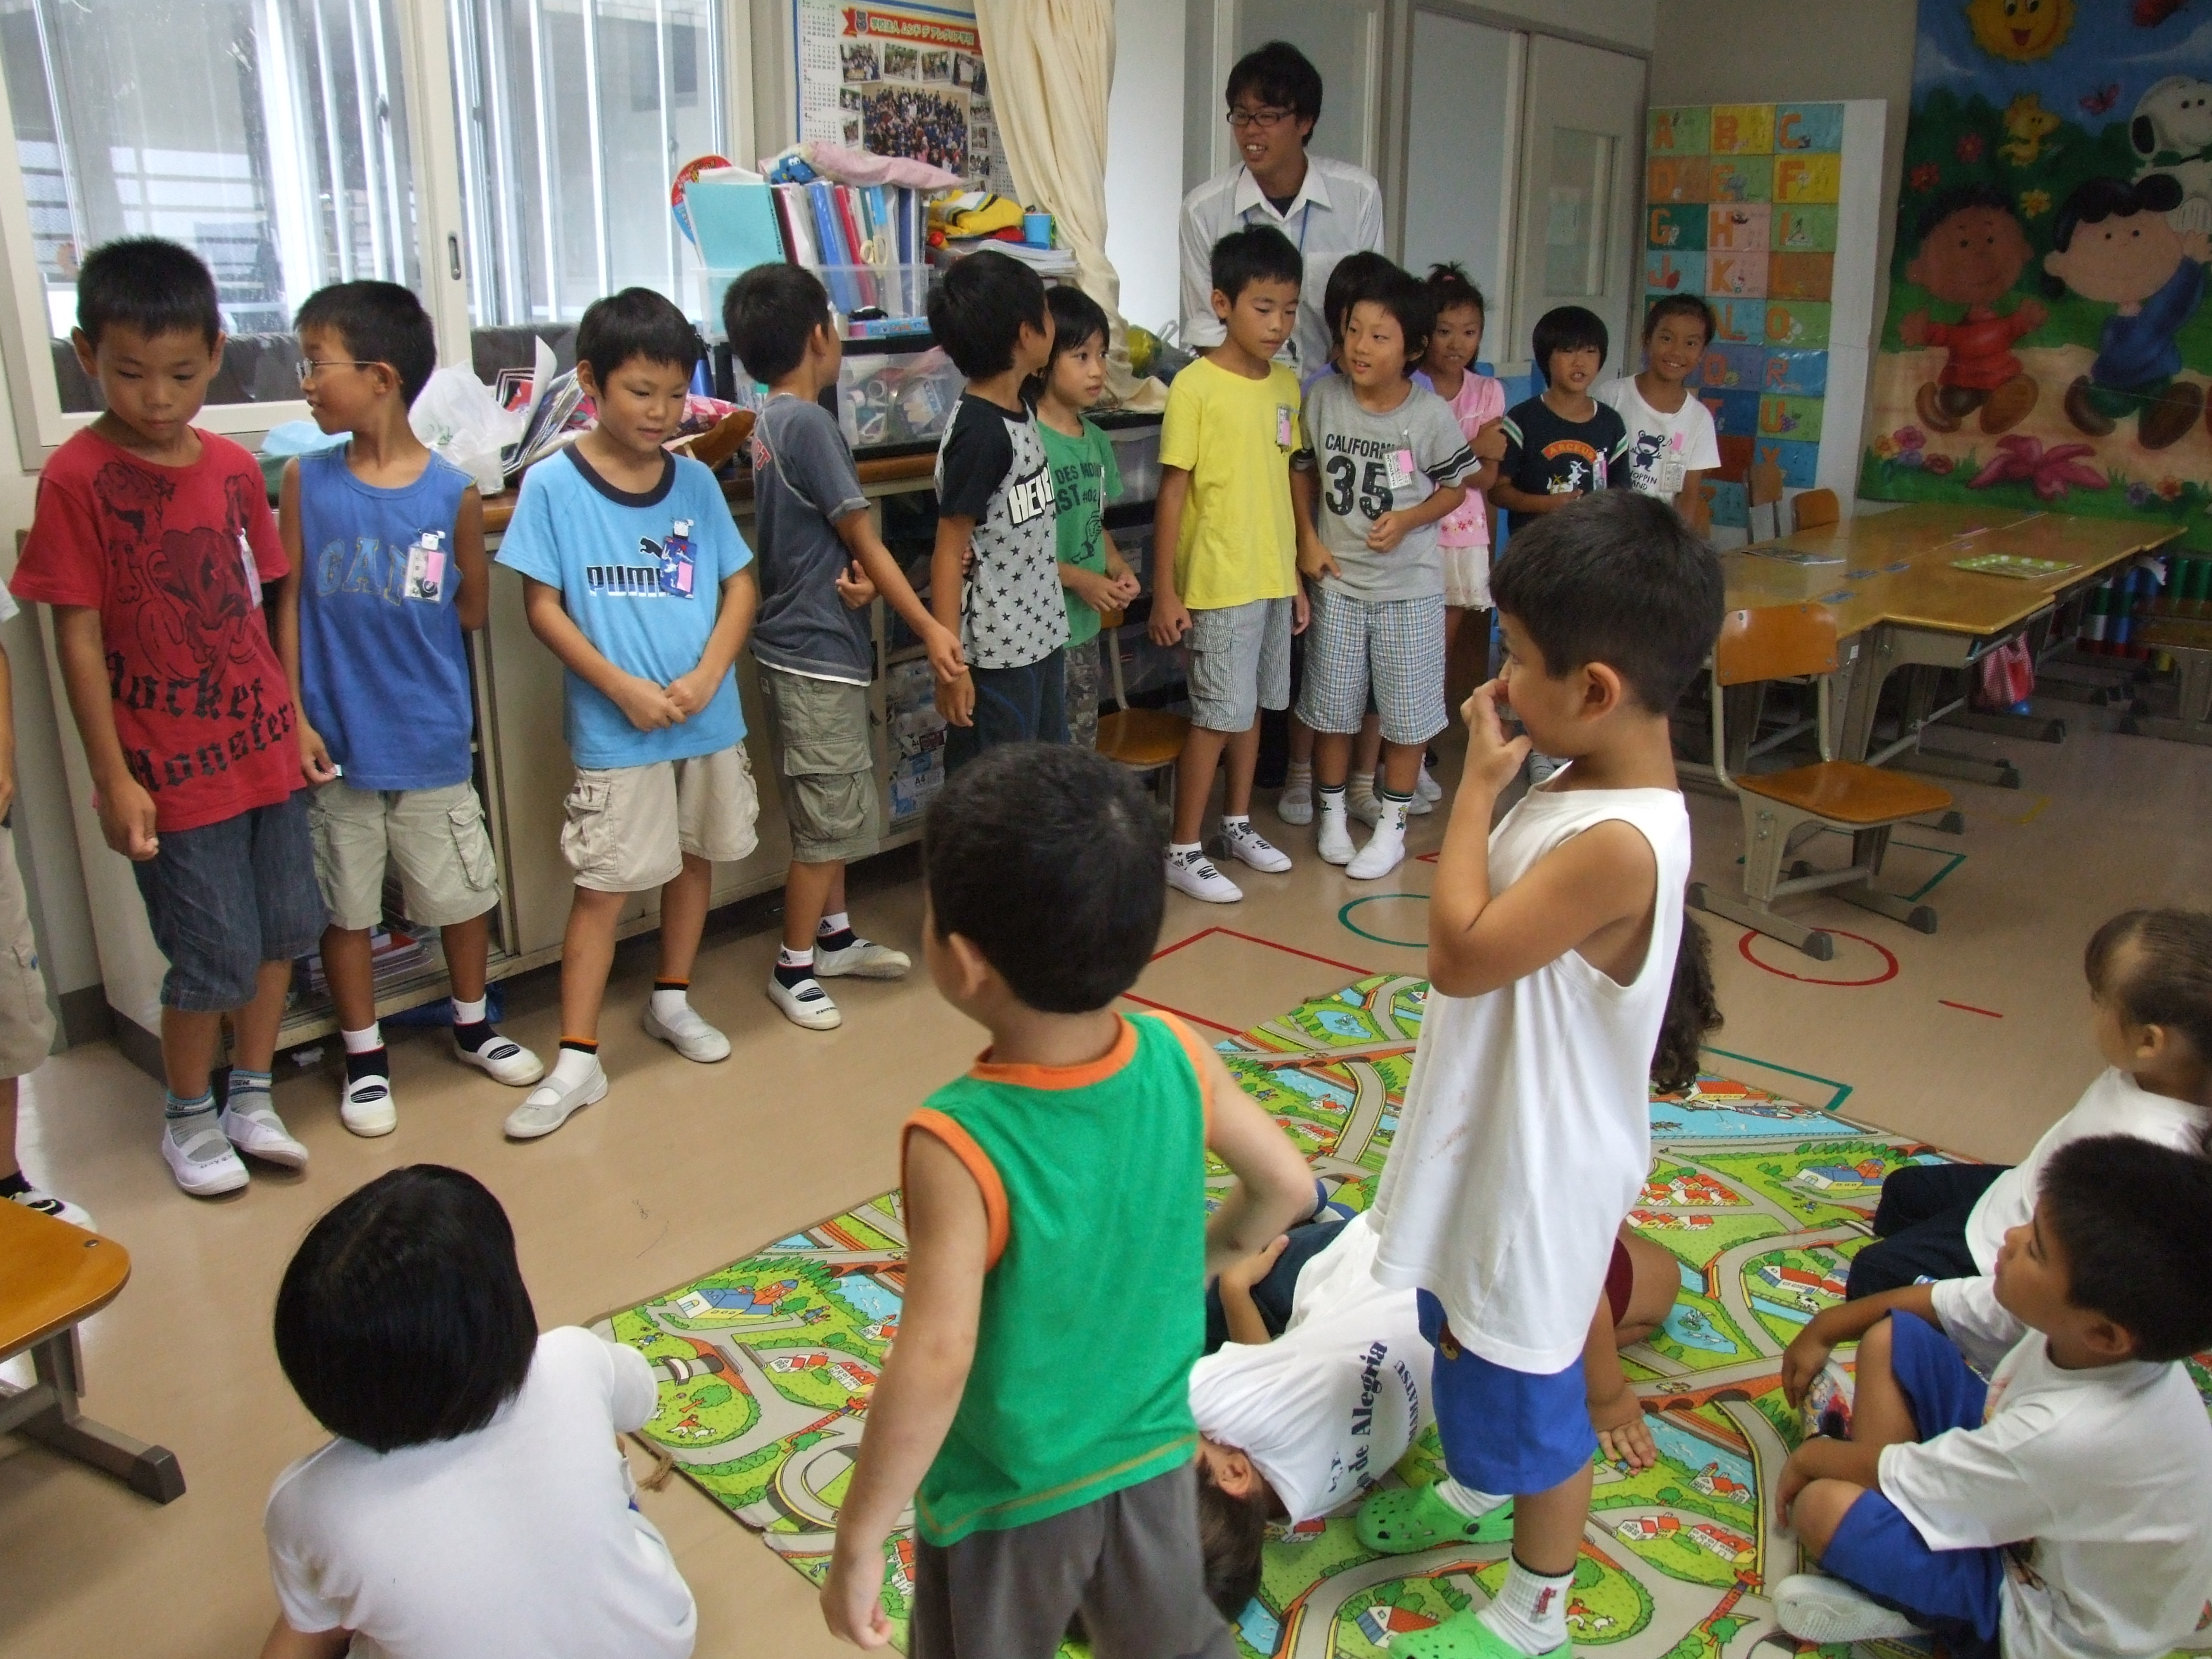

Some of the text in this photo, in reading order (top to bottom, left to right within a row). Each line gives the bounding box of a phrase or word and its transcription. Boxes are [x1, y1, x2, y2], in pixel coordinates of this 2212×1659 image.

[1653, 113, 1802, 150] A B C
[1712, 165, 1735, 200] E
[1778, 161, 1805, 200] F
[1651, 207, 1672, 245] G
[1710, 211, 1734, 247] H
[1648, 254, 1672, 288] J
[1712, 257, 1736, 292] K
[1766, 306, 1791, 340] O
[1766, 358, 1789, 389] R
[1761, 400, 1786, 433] U
[1325, 433, 1395, 460] CALIFOR
[1055, 465, 1079, 485] DES
[1325, 455, 1394, 521] 35
[126, 700, 297, 792] Monster
[1351, 1341, 1388, 1436] Alegria
[1348, 1445, 1369, 1473] de
